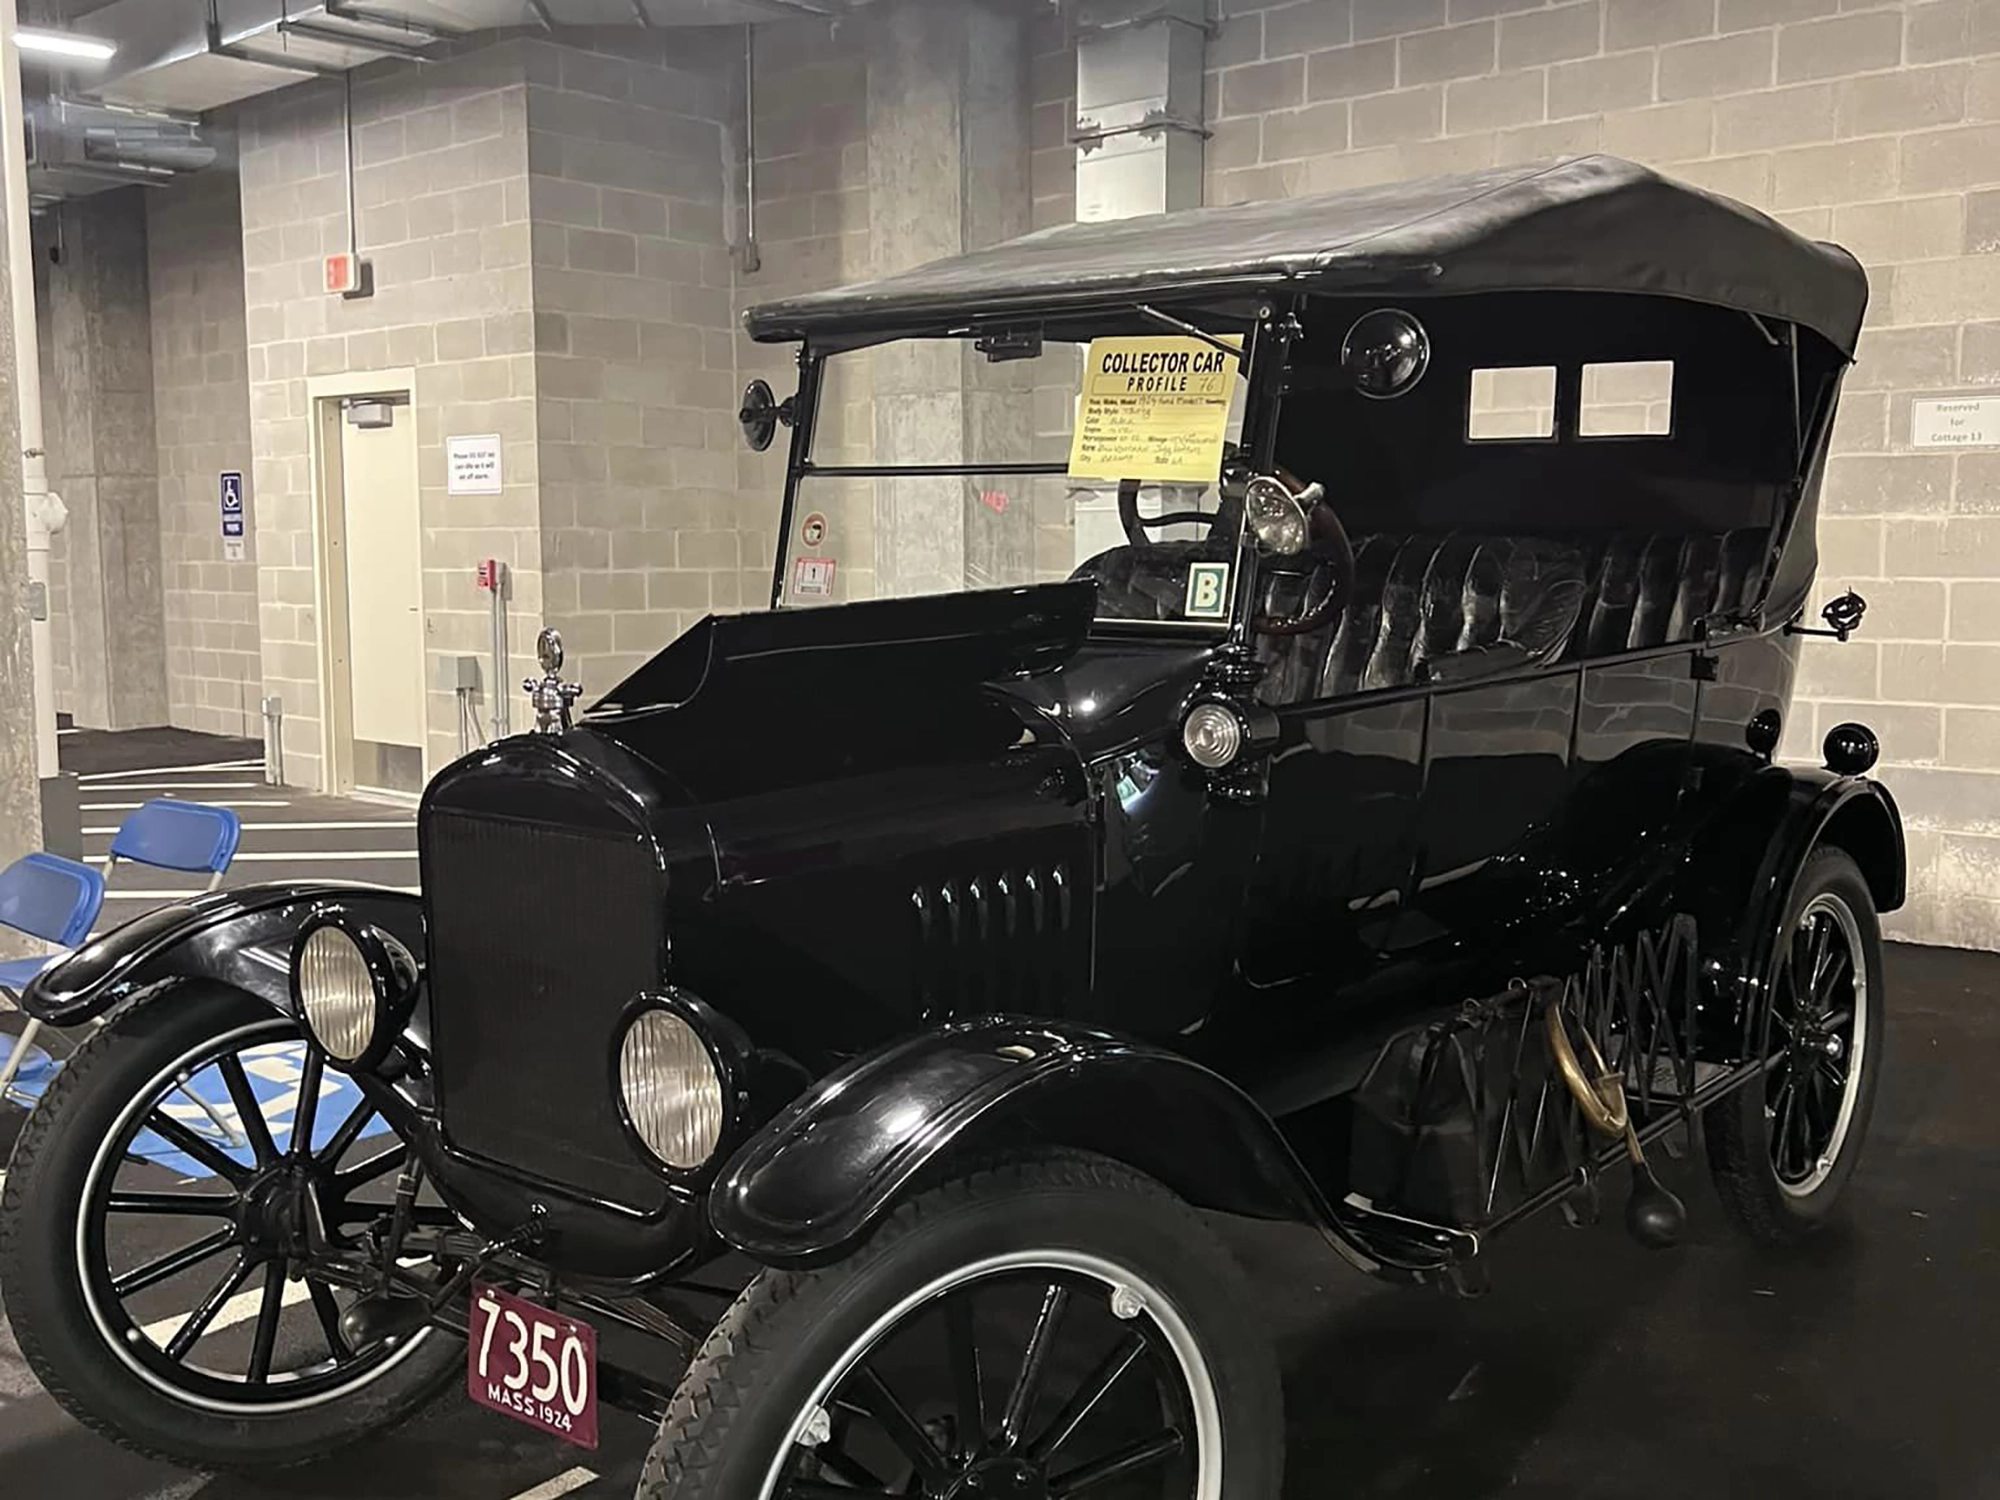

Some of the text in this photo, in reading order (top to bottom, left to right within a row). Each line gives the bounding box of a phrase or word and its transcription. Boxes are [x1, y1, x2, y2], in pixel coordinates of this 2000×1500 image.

[1102, 352, 1225, 373] COLLECTOR CAR
[1127, 377, 1187, 392] PROFILE
[1199, 377, 1217, 392] 76
[1936, 402, 1980, 412] Reserved
[1949, 418, 1965, 427] for
[1931, 433, 1969, 443] Cottage
[1195, 572, 1218, 607] B
[478, 1297, 588, 1416] 7350
[539, 1402, 573, 1433] 1924
